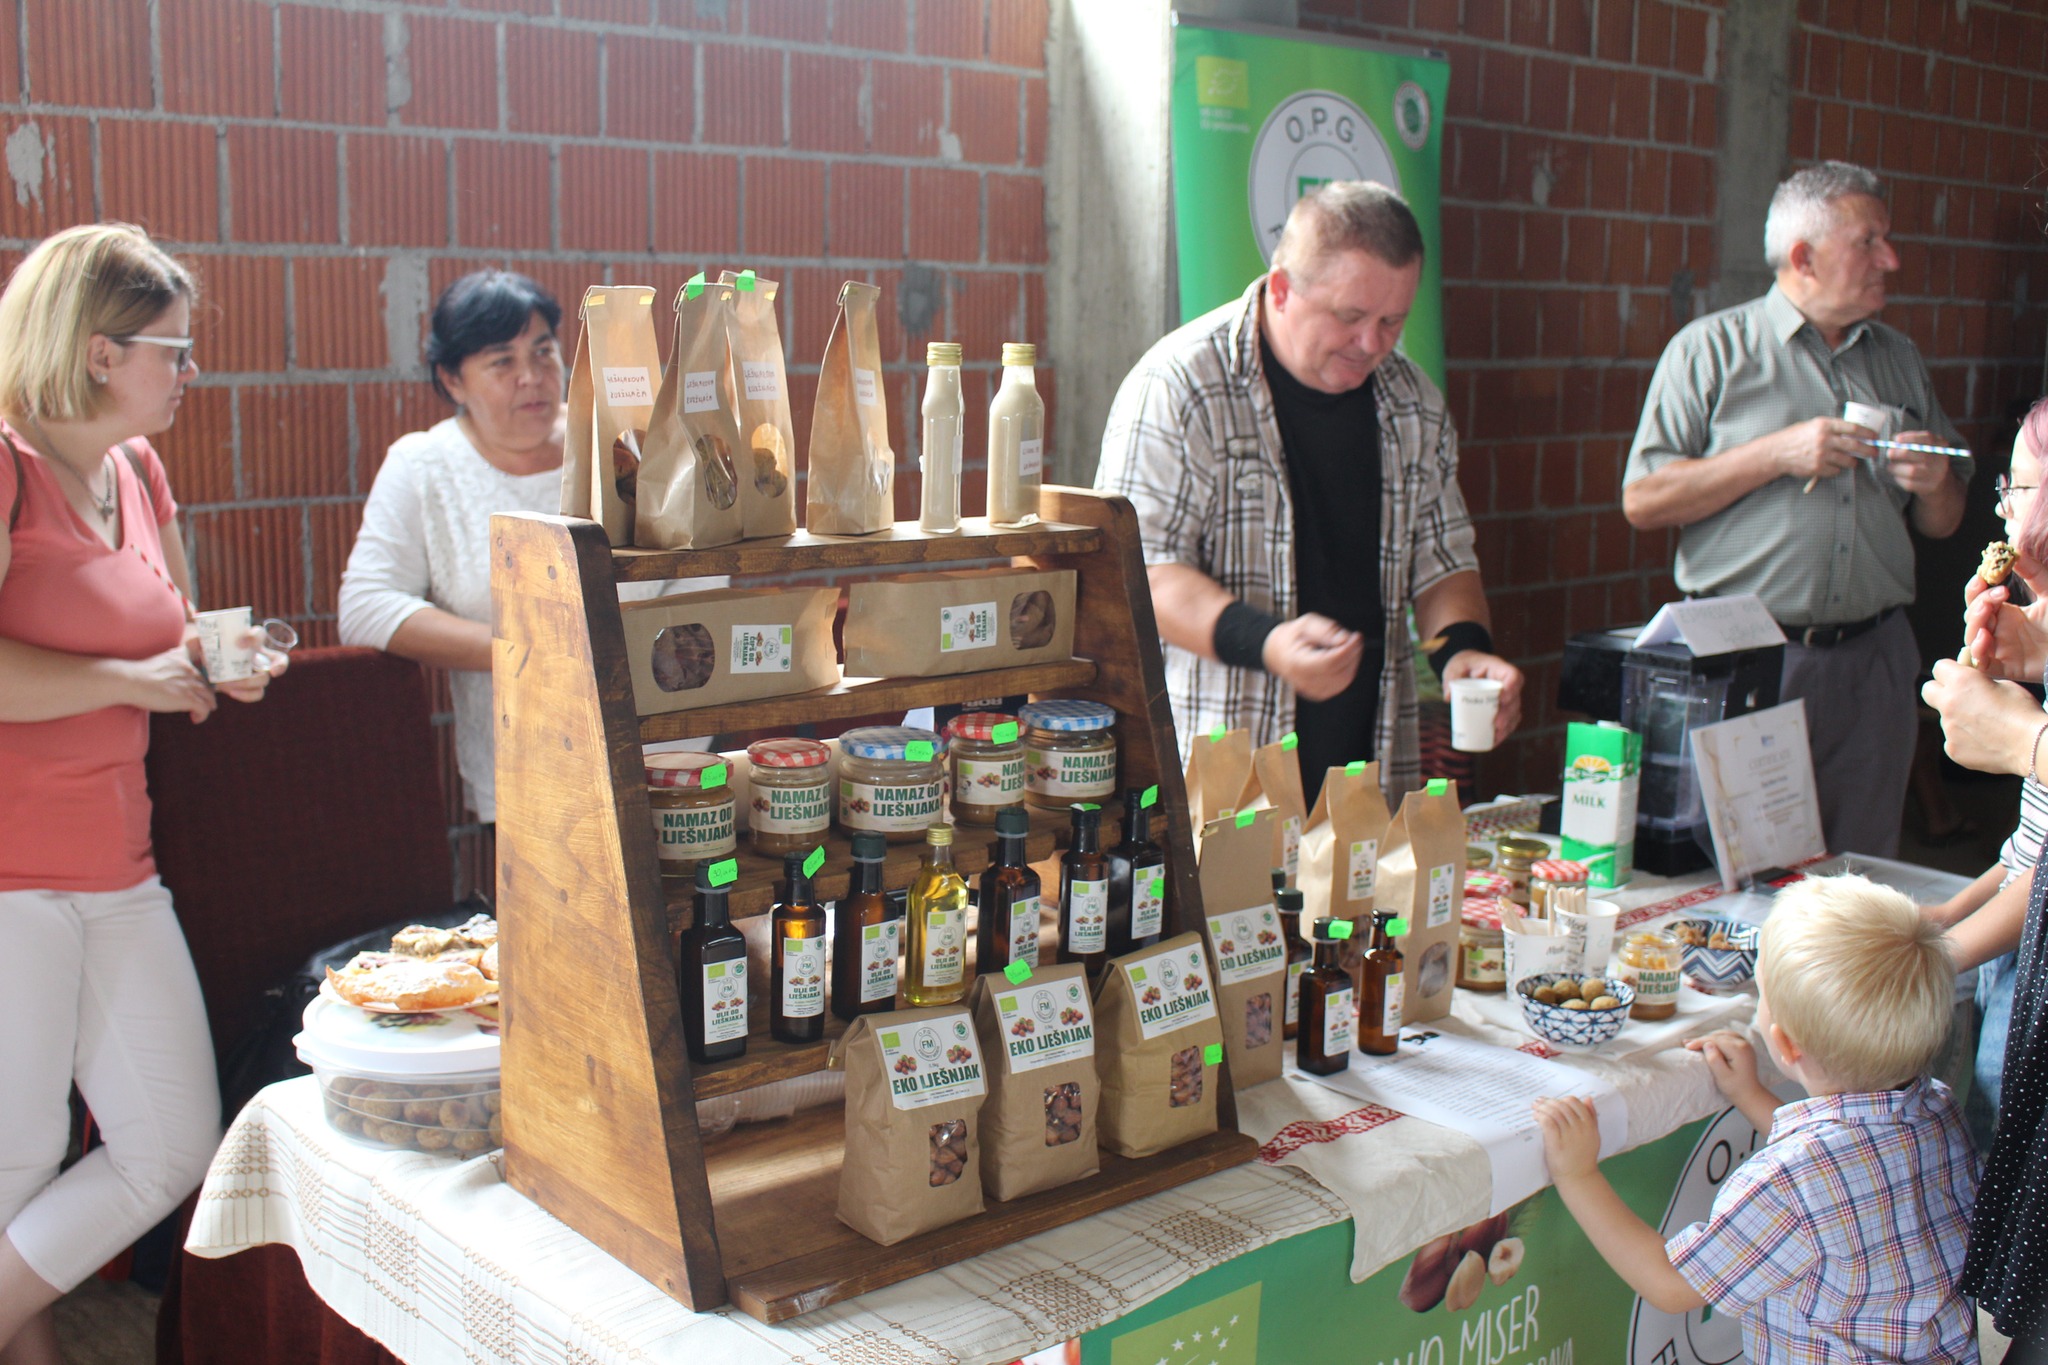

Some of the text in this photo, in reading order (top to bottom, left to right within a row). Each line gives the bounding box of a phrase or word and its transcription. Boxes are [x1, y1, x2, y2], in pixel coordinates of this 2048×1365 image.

[1285, 107, 1357, 152] O.P.G.
[1062, 755, 1106, 769] NAMAZ
[771, 789, 821, 804] NAMAZ
[874, 783, 940, 801] NAMAZ OD
[1573, 793, 1606, 809] MILK
[663, 807, 732, 828] NAMAZ OD
[873, 798, 940, 817] LJEŠNJAKA
[662, 822, 733, 844] LJEŠNJAKA
[1236, 944, 1283, 967] LJEŠNJAK
[1039, 1001, 1050, 1011] FM
[1140, 1005, 1162, 1024] EKO
[1163, 989, 1211, 1017] LJEŠNJAK
[921, 1040, 934, 1050] FM
[1009, 1038, 1035, 1057] EKO
[1036, 1025, 1093, 1050] LJEŠNJAK
[892, 1064, 980, 1095] EKO LJEŠNJAK
[1459, 1284, 1540, 1365] MISER
